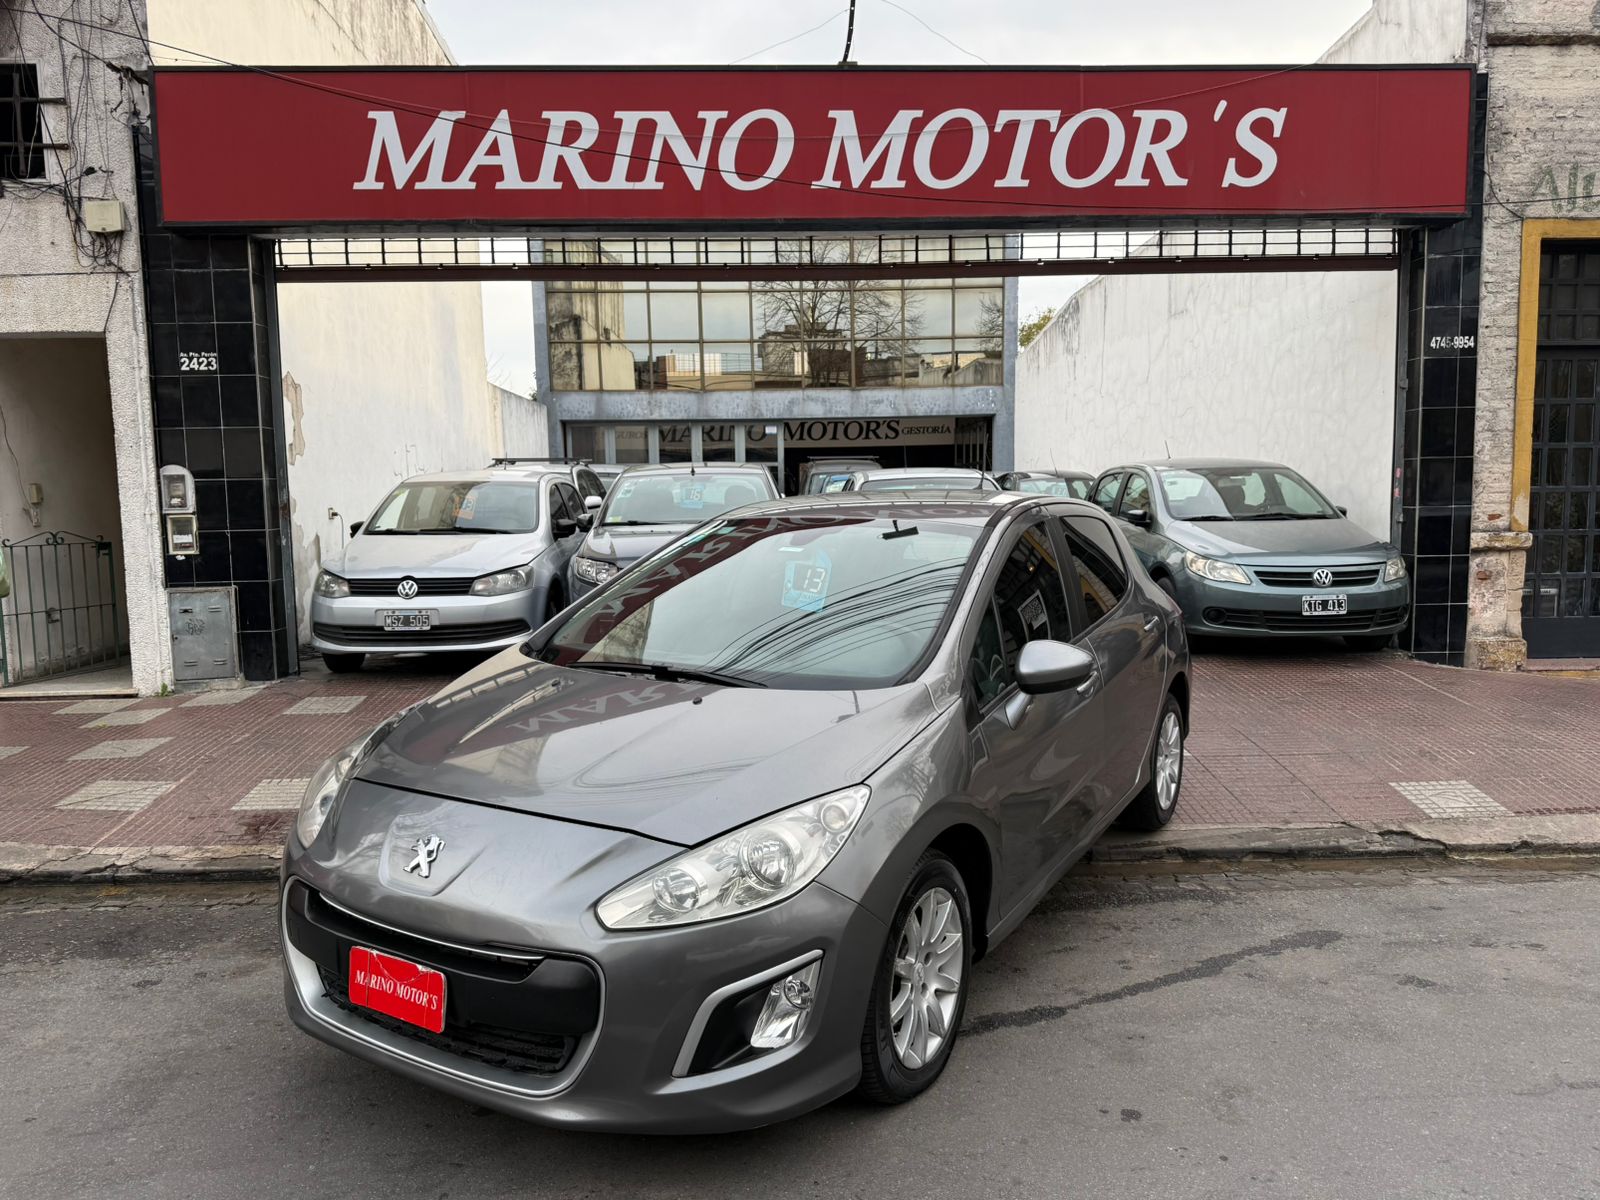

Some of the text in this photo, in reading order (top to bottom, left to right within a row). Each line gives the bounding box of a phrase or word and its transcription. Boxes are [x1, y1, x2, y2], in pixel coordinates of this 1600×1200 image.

[353, 108, 795, 191] MARINO
[1430, 335, 1475, 349] 4745-9954
[180, 357, 217, 370] 2423
[783, 418, 900, 441] MOTOR'S
[901, 423, 952, 436] GESTORÍA
[803, 567, 826, 593] 13
[1303, 600, 1346, 612] KTG 413
[385, 615, 429, 627] MSZ 505
[355, 969, 438, 1011] MARINO MOTOR'S
